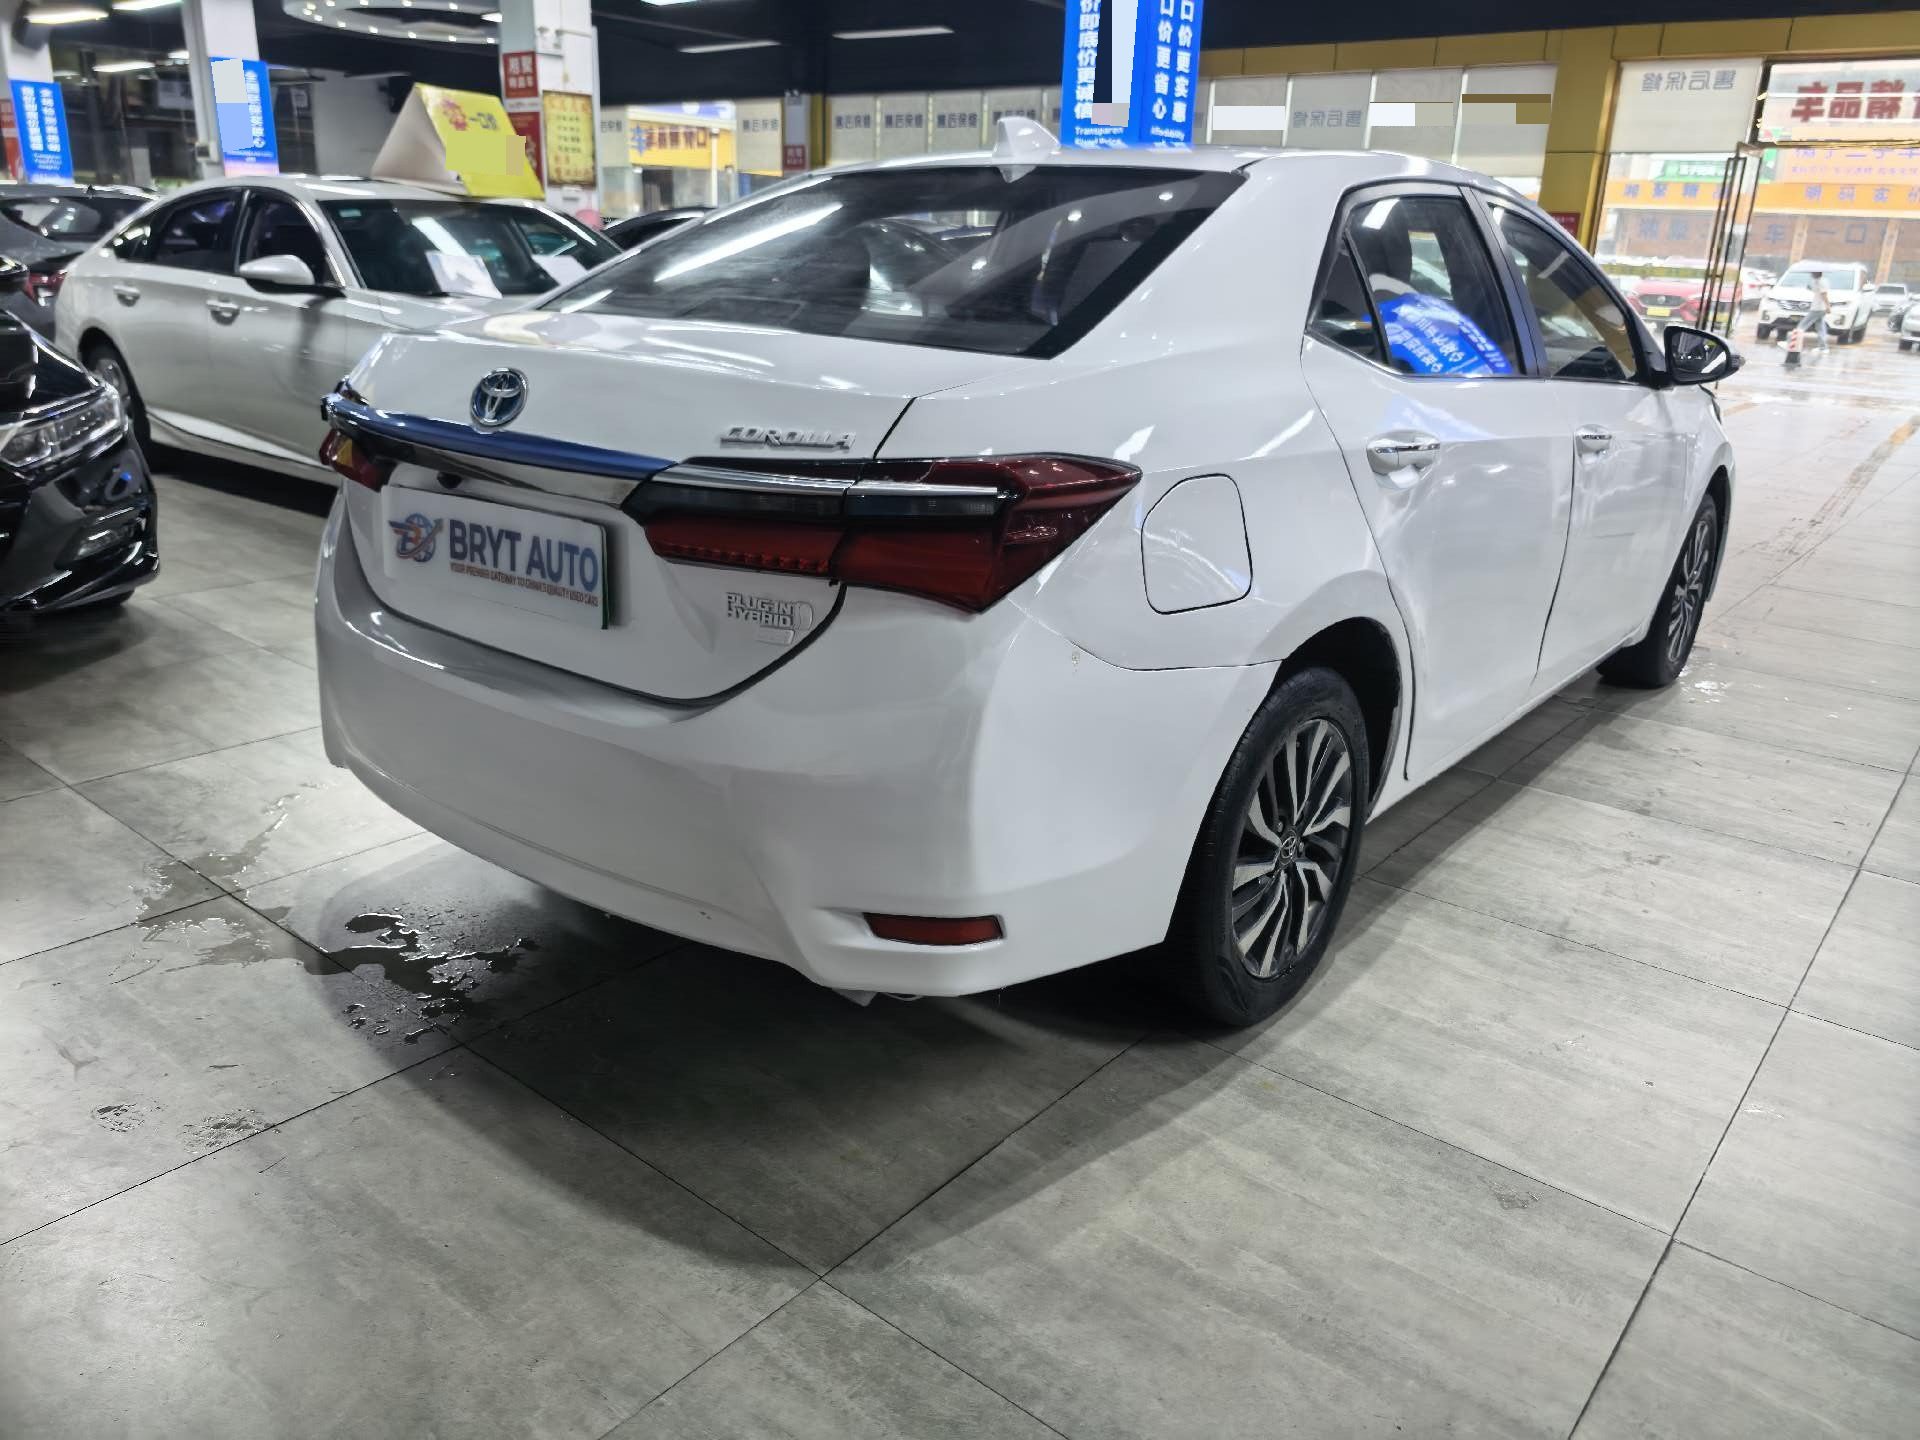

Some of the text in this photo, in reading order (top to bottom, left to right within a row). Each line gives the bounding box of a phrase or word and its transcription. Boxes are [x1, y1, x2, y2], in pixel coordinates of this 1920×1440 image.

[720, 427, 856, 449] COROLLA
[449, 519, 599, 593] BRYT AUTO
[491, 569, 517, 585] GATEWAY
